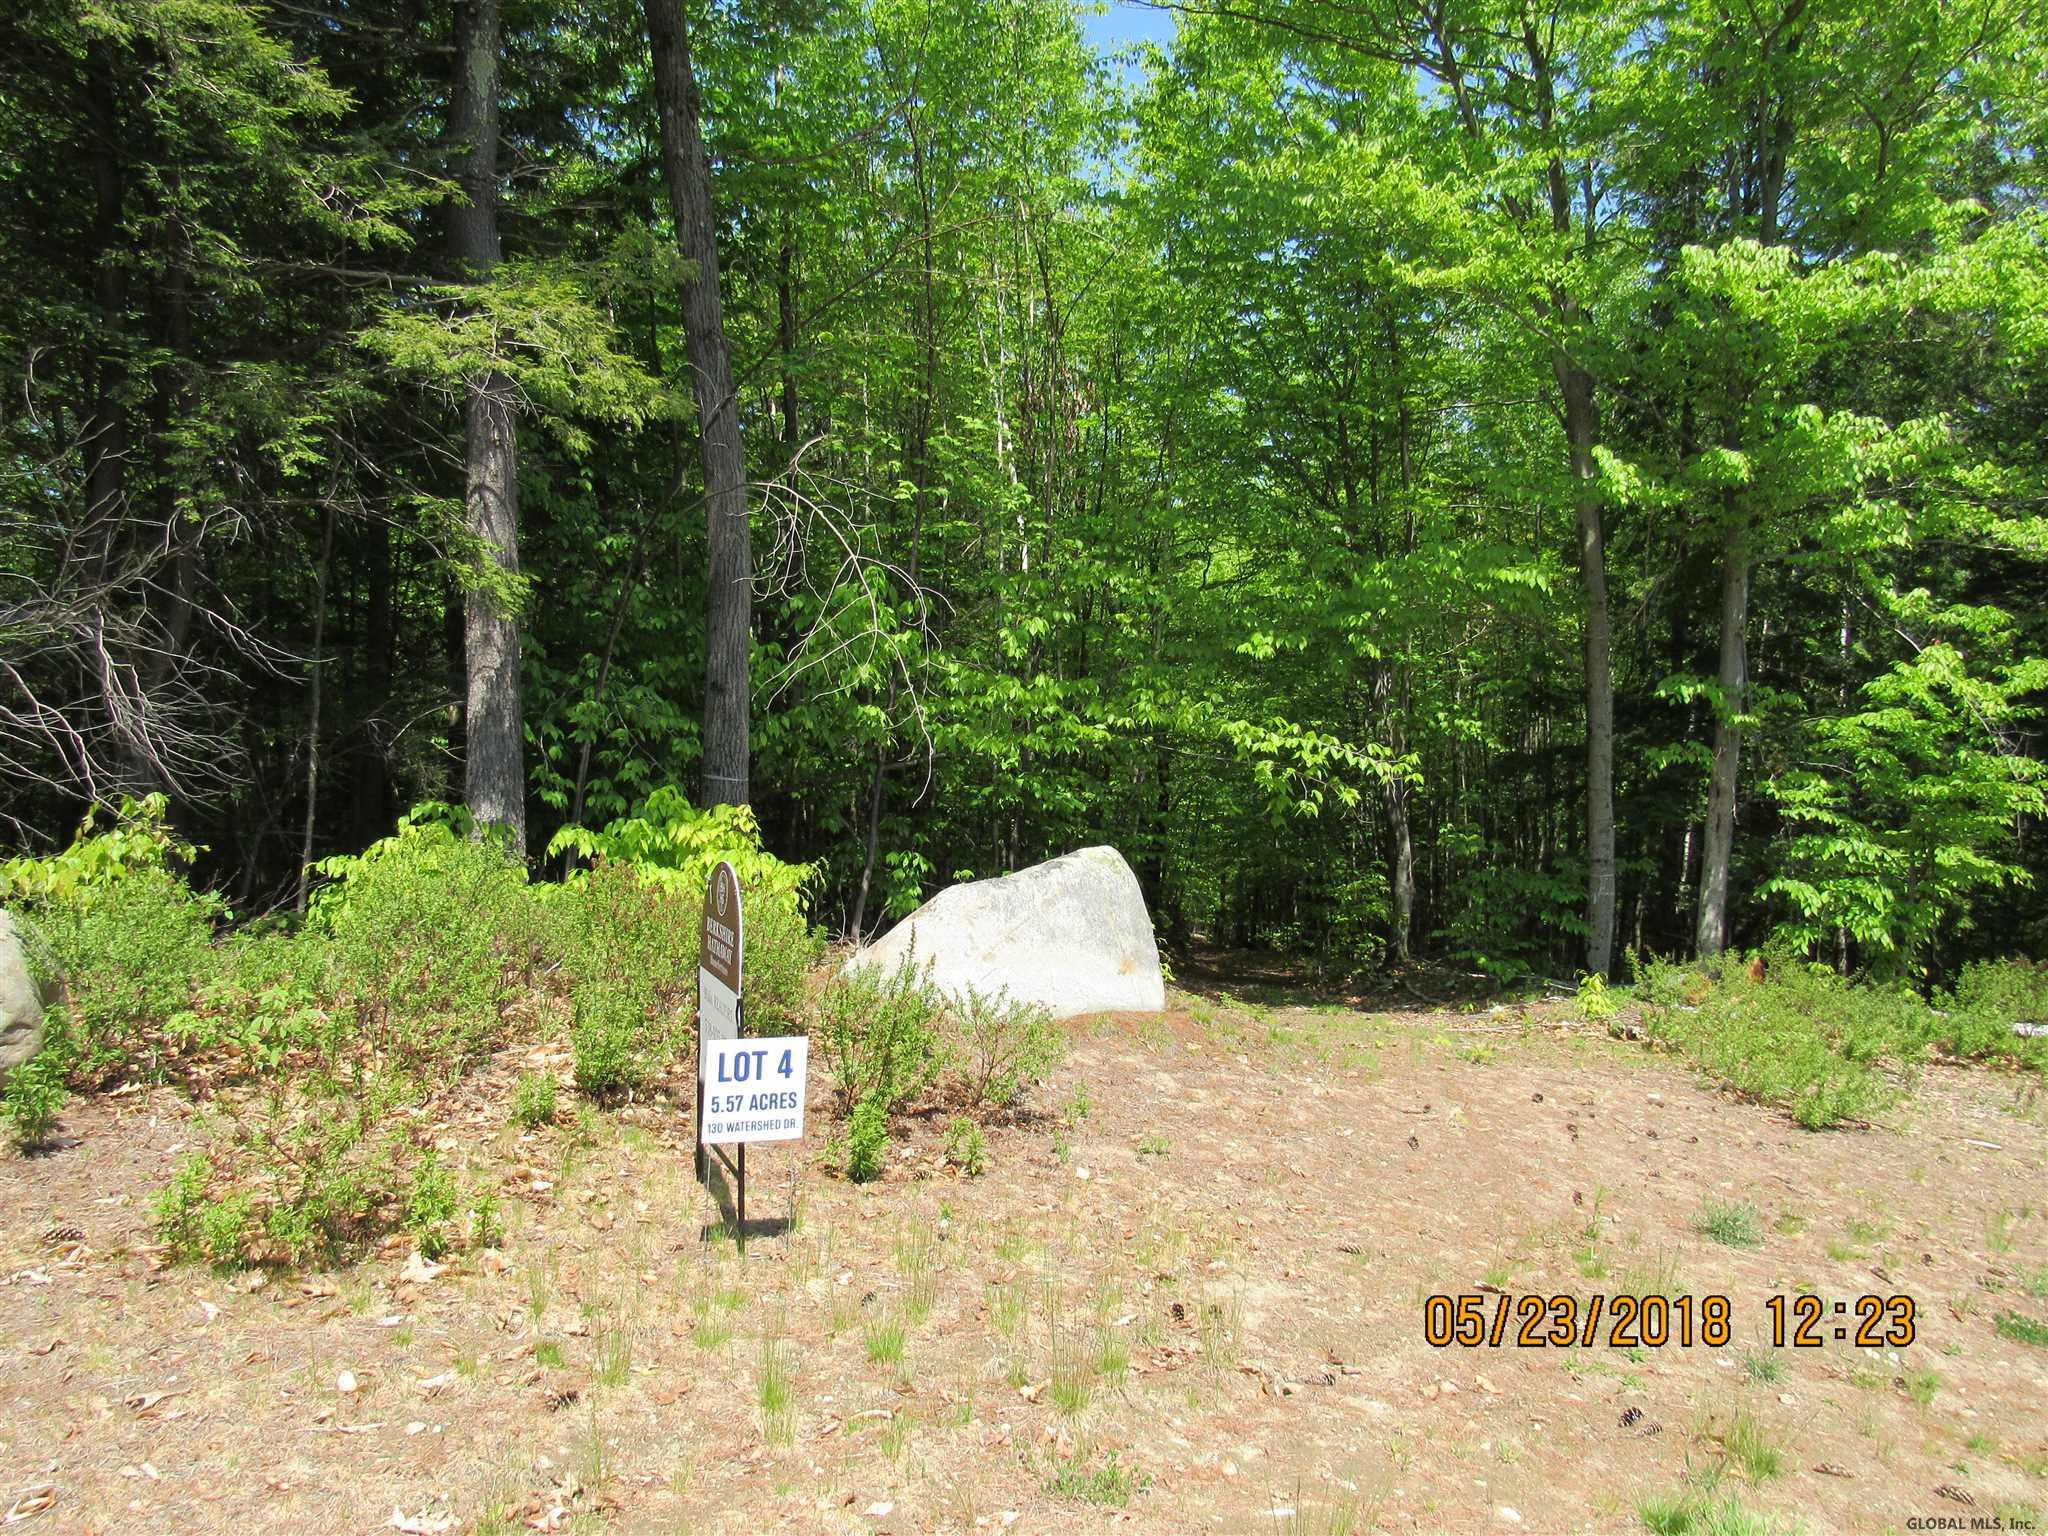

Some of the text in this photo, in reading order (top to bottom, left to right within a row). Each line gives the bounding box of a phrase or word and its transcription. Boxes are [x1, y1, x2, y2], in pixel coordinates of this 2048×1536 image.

[718, 1049, 794, 1083] LOT 4
[711, 1091, 798, 1114] 5.57 ACRES
[707, 1122, 723, 1134] 130
[726, 1119, 781, 1133] WATERSHED
